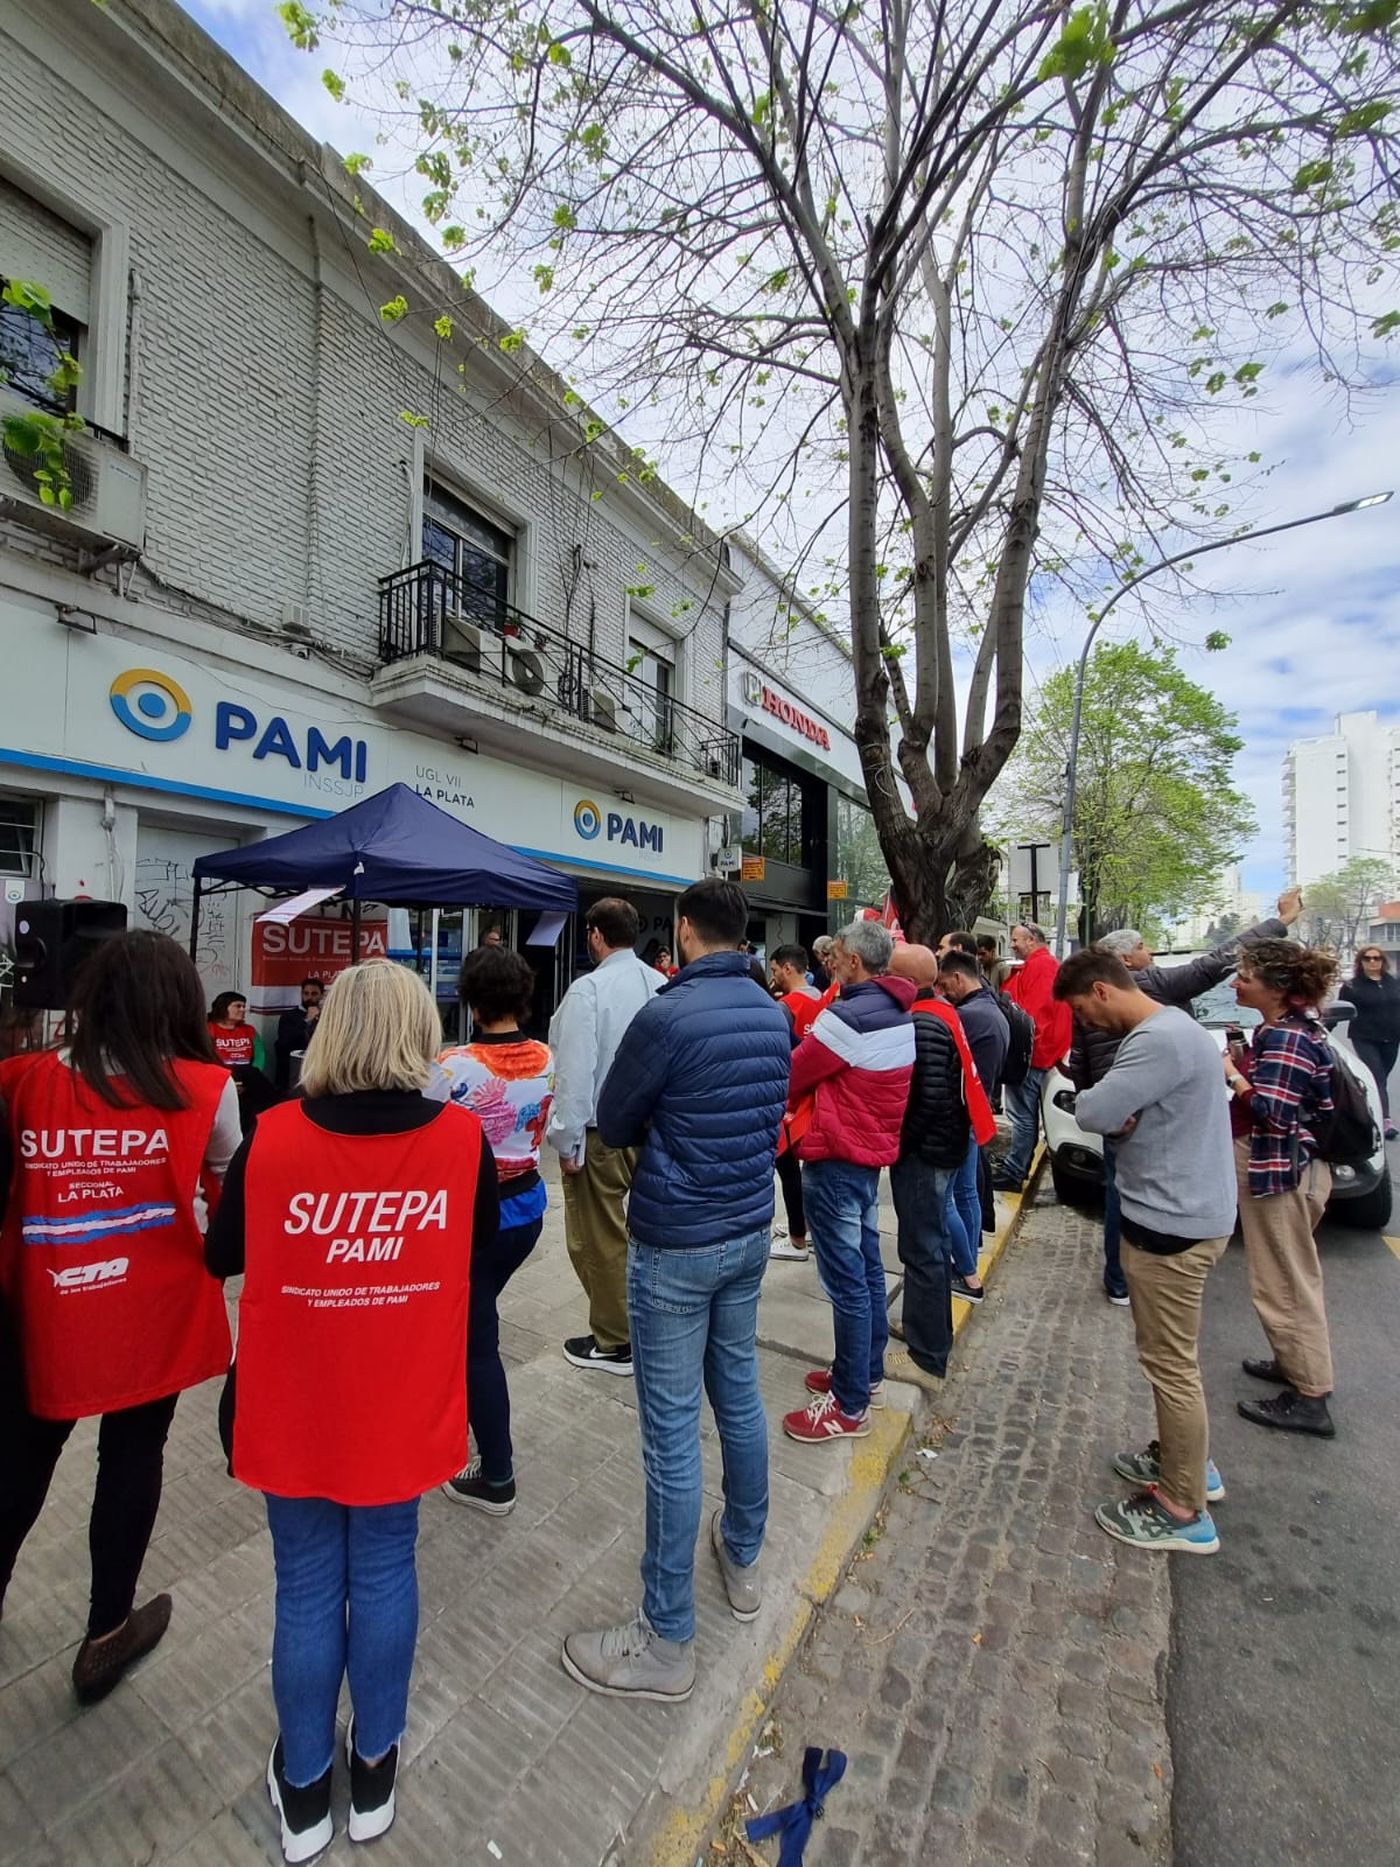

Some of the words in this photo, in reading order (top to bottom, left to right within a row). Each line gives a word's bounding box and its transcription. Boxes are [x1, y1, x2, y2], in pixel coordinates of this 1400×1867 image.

[761, 685, 831, 752] HONDA
[215, 701, 367, 783] PAMI
[415, 764, 442, 784] UGL
[446, 773, 461, 788] VII
[415, 783, 433, 798] LA
[437, 788, 475, 809] PLATA
[607, 812, 664, 853] PAMI
[262, 924, 386, 955] SUTEPA
[307, 970, 320, 979] LA
[20, 1129, 169, 1158] SUTEPA
[100, 1157, 167, 1168] TRABAJADORES
[116, 1166, 137, 1174] PAMI
[58, 1192, 79, 1203] LA
[82, 1186, 124, 1199] PLATA
[284, 1189, 448, 1235] SUTEPA
[325, 1236, 404, 1264] PAMI
[281, 1285, 322, 1297] SINDICATO
[323, 1287, 353, 1297] UNIDO
[354, 1286, 368, 1295] DE
[369, 1281, 440, 1295] TRABAJADORES
[313, 1297, 370, 1308] EMPLEADOS
[371, 1296, 385, 1305] DE
[386, 1295, 409, 1304] PAMI
